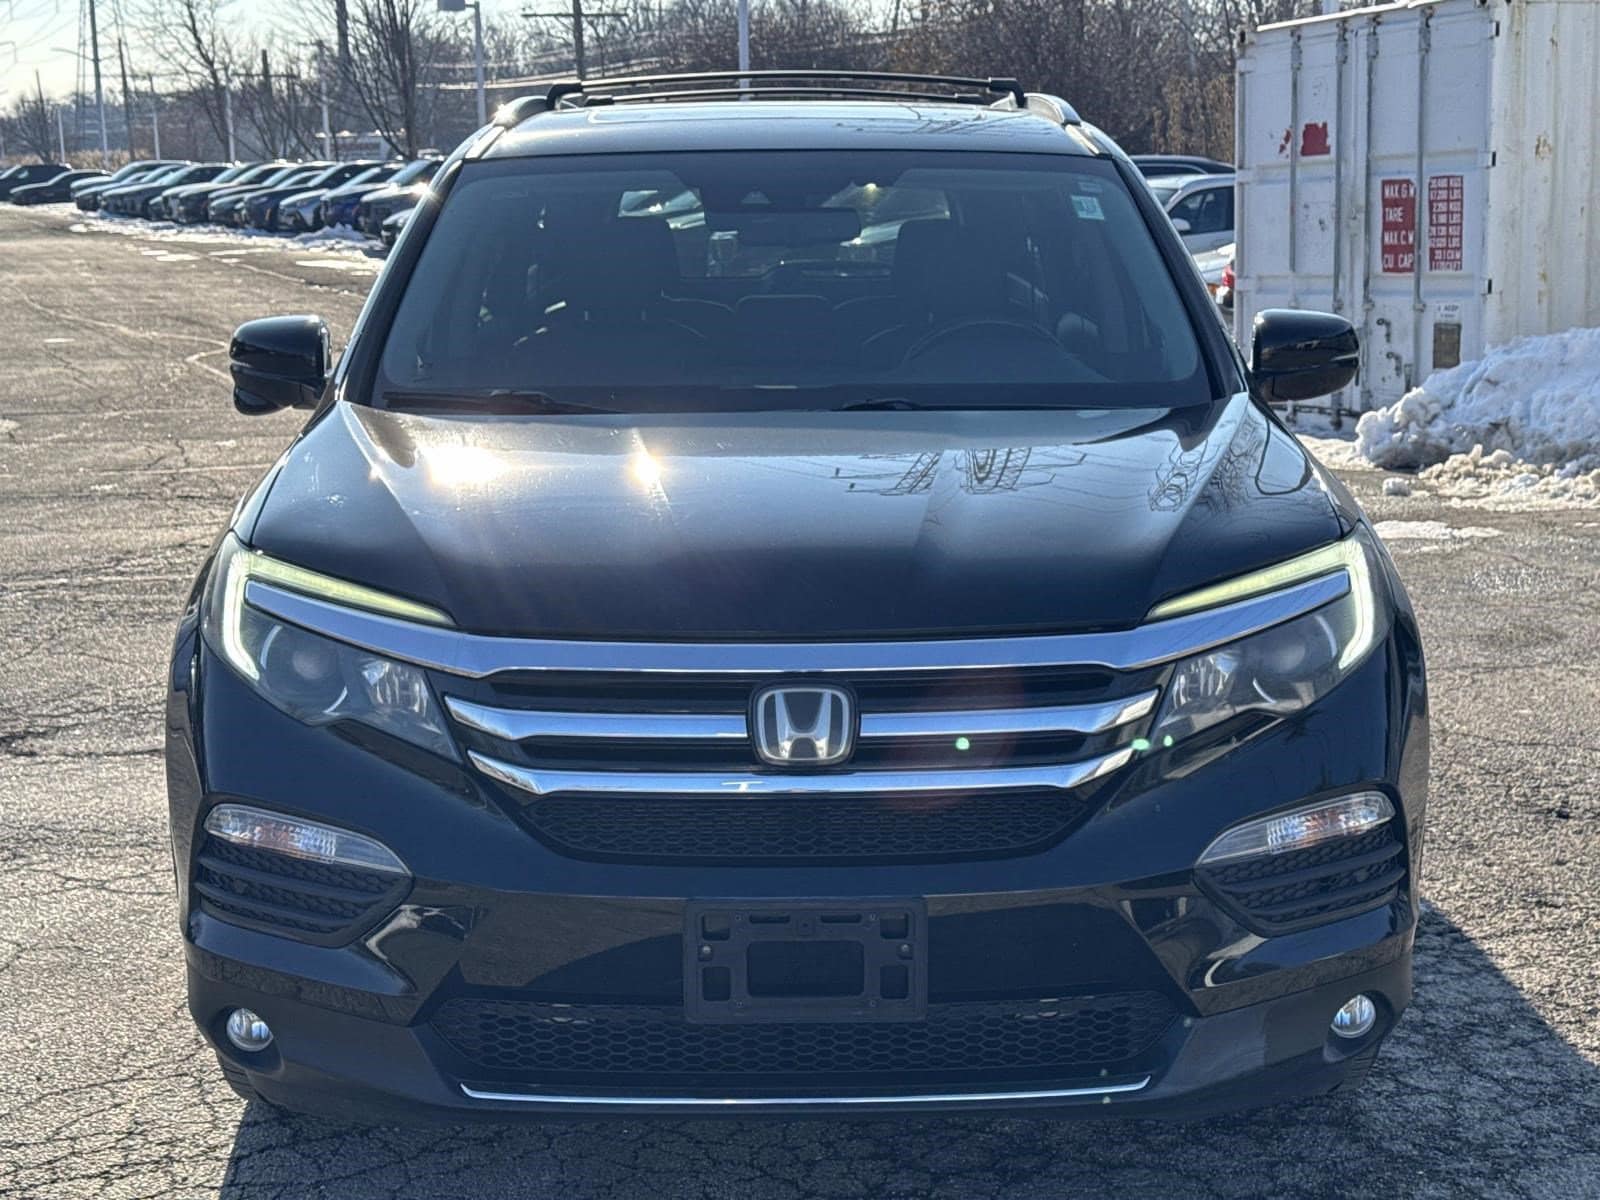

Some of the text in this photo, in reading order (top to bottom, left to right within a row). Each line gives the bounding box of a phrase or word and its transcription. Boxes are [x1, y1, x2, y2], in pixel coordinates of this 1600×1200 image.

[1385, 207, 1404, 223] TARE
[1383, 254, 1395, 269] CU
[1398, 253, 1414, 269] CAP
